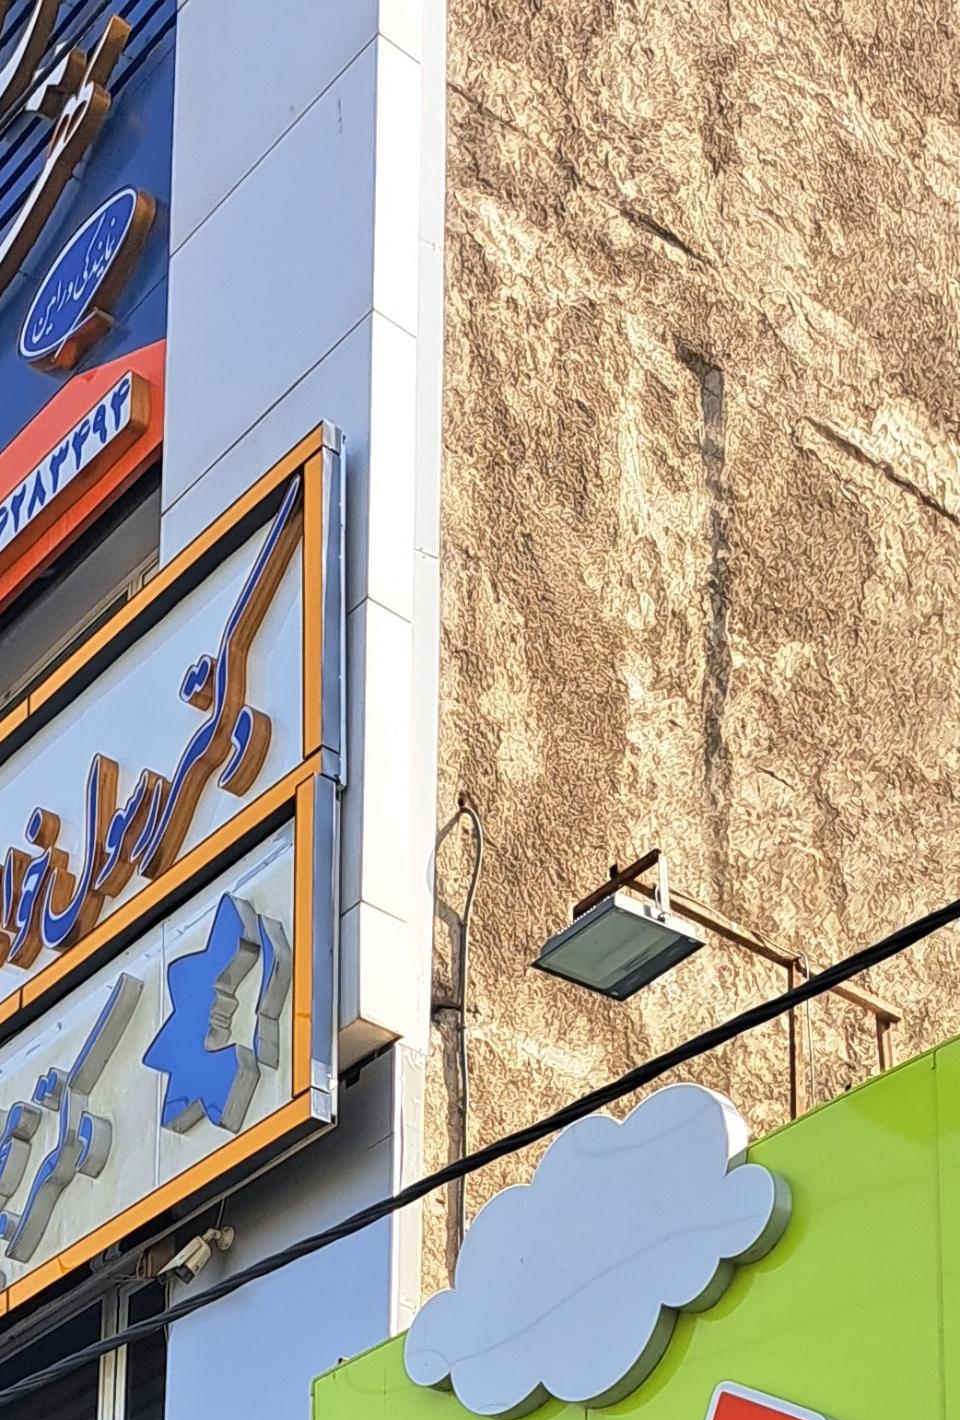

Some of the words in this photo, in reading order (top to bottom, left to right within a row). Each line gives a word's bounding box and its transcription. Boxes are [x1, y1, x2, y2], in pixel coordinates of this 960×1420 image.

[31, 279, 74, 344] ورامین
[141, 474, 302, 877] دکتر
[41, 752, 162, 949] رسول
[8, 973, 130, 1260] دکتر
